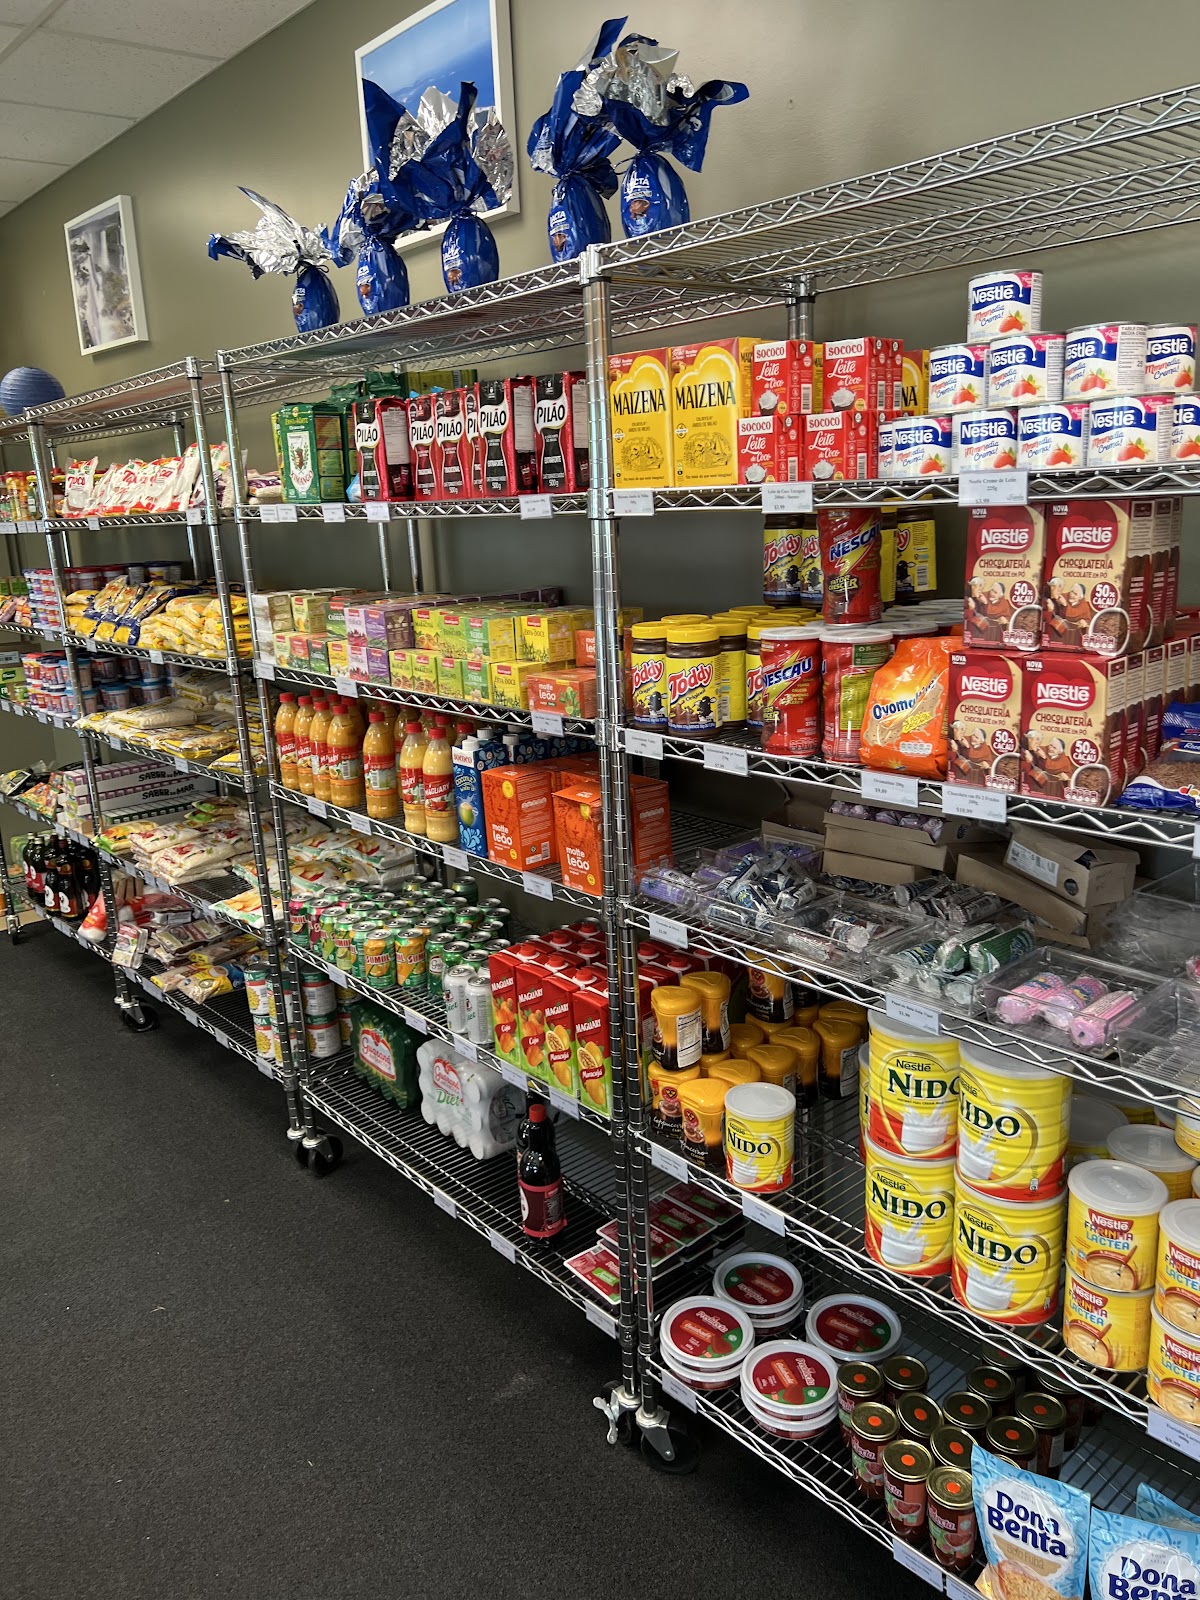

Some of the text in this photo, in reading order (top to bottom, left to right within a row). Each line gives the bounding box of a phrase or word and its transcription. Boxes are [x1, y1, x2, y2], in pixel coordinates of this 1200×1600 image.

[972, 284, 1014, 305] Nestlé
[756, 346, 785, 359] SOCOCO
[828, 343, 863, 356] SOCOCO
[1066, 341, 1096, 360] estlé
[990, 349, 1027, 367] Nestlé
[755, 362, 780, 381] Leite
[827, 360, 856, 379] Leite
[930, 358, 966, 375] Nestlé
[769, 379, 784, 389] Coco
[844, 376, 862, 386] Coco
[613, 388, 667, 416] MAIZENA
[675, 381, 736, 410] MAIZENA
[480, 408, 507, 427] PILÃO
[537, 402, 566, 425] PILÃO
[1093, 409, 1135, 429] Nestlé
[437, 420, 462, 438] PILÃO
[741, 420, 771, 433] SOCOCO
[808, 416, 840, 428] SOCOCO
[961, 421, 1007, 439] Nestlé
[1020, 415, 1062, 435] Nestlé
[356, 426, 378, 442] PILÃO
[411, 423, 434, 442] PILÃO
[809, 431, 834, 450] Leite
[895, 429, 933, 445] Nestlé
[740, 436, 767, 455] Leite
[756, 454, 771, 462] Coco
[824, 450, 840, 459] Coco
[973, 447, 998, 461] Crema!
[549, 479, 559, 487] 500g
[981, 528, 1029, 544] Nestlé
[1062, 527, 1112, 544] Nestlé
[764, 534, 802, 570] Toddy
[1014, 583, 1033, 596] 50%
[1095, 585, 1115, 598] 50%
[1012, 595, 1033, 603] CACAU
[1093, 597, 1115, 605] CACAU
[763, 656, 812, 688] NESCAU
[1026, 661, 1043, 669] NOVA
[631, 660, 664, 693] Toddy
[669, 664, 713, 704] Toddy
[962, 676, 1008, 693] Nestlé
[538, 683, 553, 692] matte
[539, 688, 556, 701] leão
[686, 688, 706, 702] Original
[1037, 684, 1090, 702] Nestlé
[964, 716, 991, 724] CHOCOLATE
[995, 731, 1013, 744] 50%
[1040, 726, 1071, 735] CHOCOLATE
[993, 742, 1014, 750] CACAU
[1075, 741, 1096, 755] 50%
[453, 754, 472, 764] SOCOCO
[1073, 753, 1096, 762] CACAU
[177, 784, 195, 795] MAR
[425, 783, 450, 796] MAGUARY
[492, 824, 508, 834] matte
[493, 831, 512, 845] leão
[566, 847, 585, 858] matte
[566, 853, 590, 871] leão
[366, 954, 390, 964] SUMOL
[491, 977, 514, 992] MAGUARY
[518, 988, 543, 1003] MAGUARY
[545, 1003, 569, 1017] MAGUARY
[501, 1024, 511, 1033] Caju
[576, 1019, 601, 1033] MAGUARY
[528, 1037, 540, 1046] Caju
[361, 1036, 391, 1065] Guaraná
[550, 1052, 570, 1061] Maracujá
[896, 1059, 931, 1072] Nestlé
[582, 1069, 603, 1080] Maracujá
[437, 1090, 459, 1106] Diet
[728, 1129, 771, 1155] NIDO
[877, 1173, 906, 1192] Nestlé
[871, 1180, 947, 1221] NIDO
[964, 1211, 994, 1232] Nestlé
[1091, 1213, 1129, 1231] Nestlé
[1084, 1221, 1134, 1241] FARINHA
[958, 1217, 1038, 1265] NIDO
[1073, 1282, 1103, 1306] Nestlé
[1069, 1289, 1108, 1318] FARINHA
[696, 1310, 729, 1334] Predilecta
[839, 1305, 876, 1327] Predilecta
[684, 1322, 713, 1340] Goiabada
[796, 1358, 815, 1387] Predilecta
[996, 1490, 1060, 1536] Dona
[987, 1506, 1068, 1559] Benta
[1121, 1556, 1196, 1595] Dona
